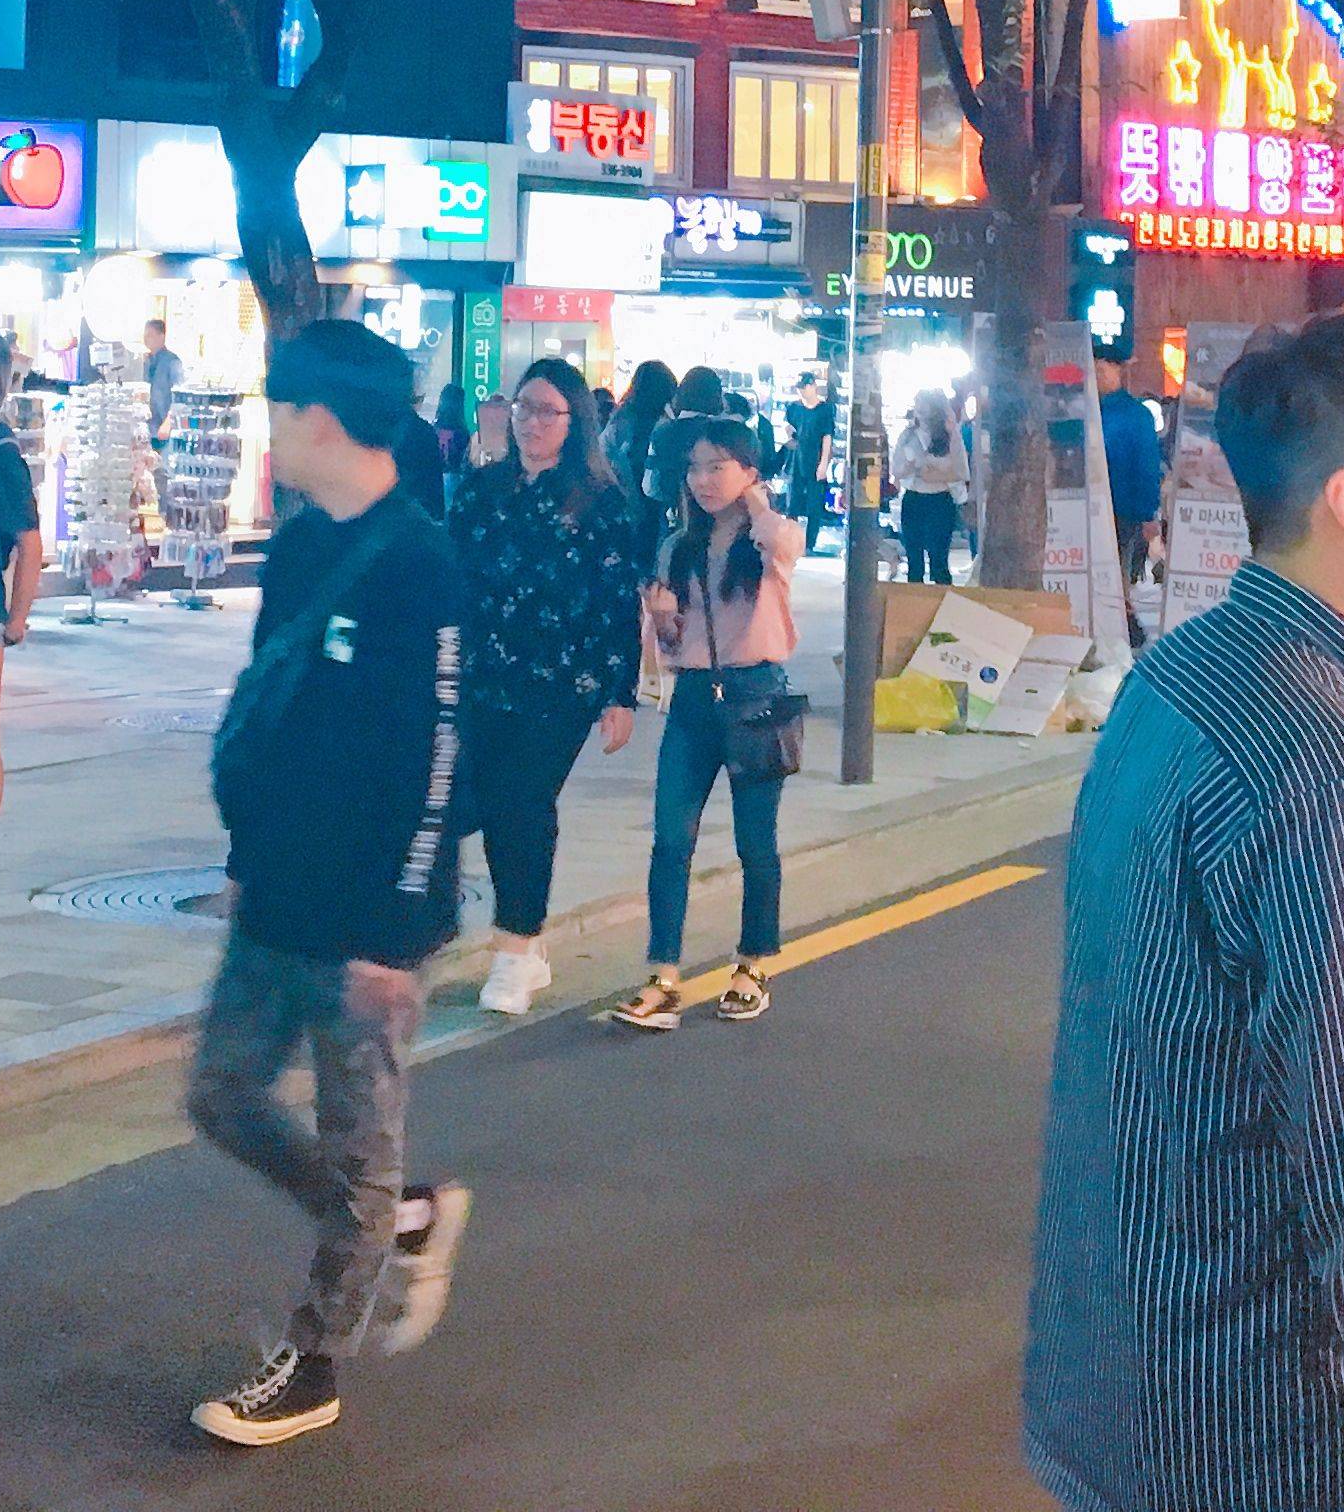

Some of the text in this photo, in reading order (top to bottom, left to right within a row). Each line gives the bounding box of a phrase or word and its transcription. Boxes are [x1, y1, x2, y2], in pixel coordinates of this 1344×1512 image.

[552, 100, 655, 160] 부동산
[884, 274, 974, 299] AVENUE
[533, 294, 592, 316] 부동산
[474, 338, 491, 424] 라디오
[1198, 509, 1242, 529] 마사지
[1047, 547, 1084, 566] 00원
[1173, 580, 1200, 599] 전신
